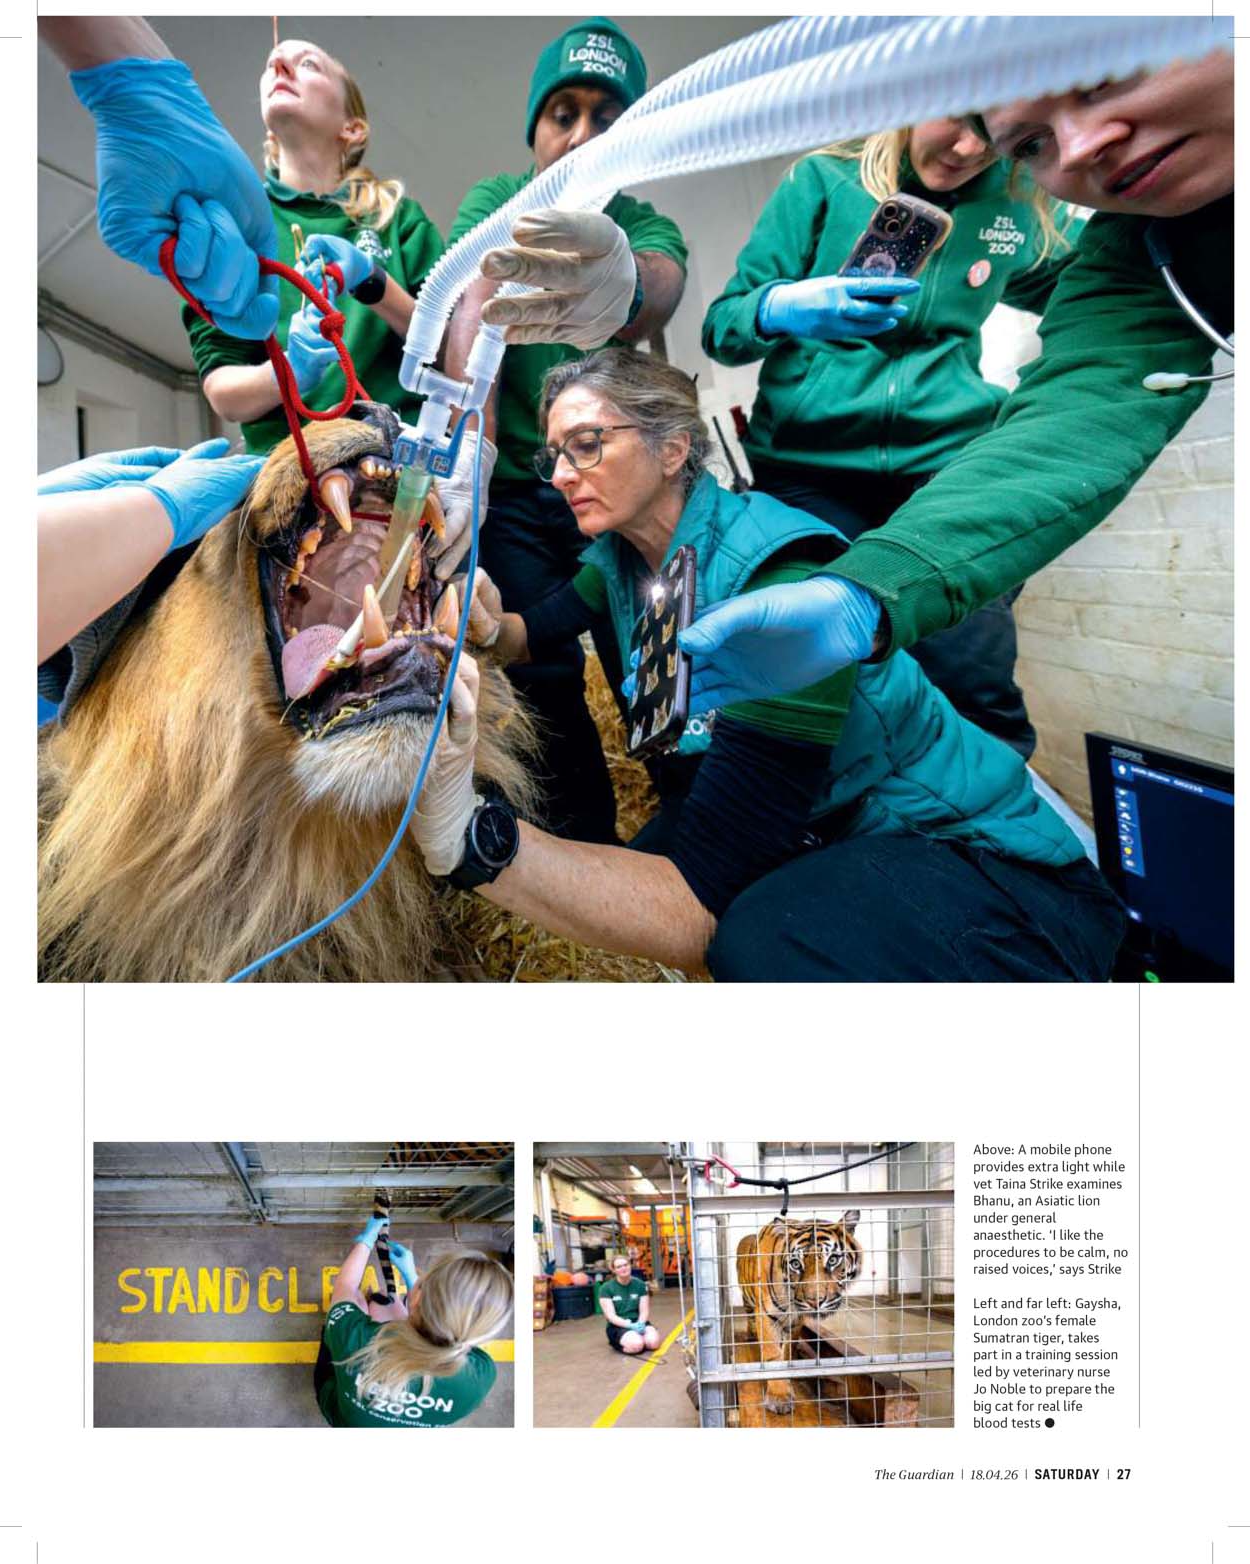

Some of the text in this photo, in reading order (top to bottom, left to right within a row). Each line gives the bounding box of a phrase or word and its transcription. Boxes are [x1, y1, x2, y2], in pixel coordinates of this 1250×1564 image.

[586, 33, 615, 52] ZSL
[568, 48, 627, 76] LONDON
[582, 61, 615, 77] ZOO
[993, 215, 1017, 229] ZSL
[978, 228, 1026, 245] LONDON
[988, 242, 1016, 255] ZOO
[974, 1144, 1111, 1157] Above: A mobile phone
[974, 1161, 1125, 1174] provides extra light while
[974, 1178, 1122, 1189] vet Taina Strike examines
[974, 1195, 1100, 1208] Bhanu, an Asiatic lion
[117, 1267, 250, 1314] STAND
[974, 1297, 1120, 1311] Left and far left: Gaysha,
[974, 1332, 1099, 1346] Sumatran tiger, takes
[974, 1349, 1118, 1362] part in a training session
[974, 1366, 1110, 1379] led by veterinary nurse
[974, 1383, 1114, 1397] Jo Noble to prepare the
[371, 1399, 422, 1418] ZOO
[875, 1469, 1131, 1480] The Guardian 18.04.26 SATURDAY 27
